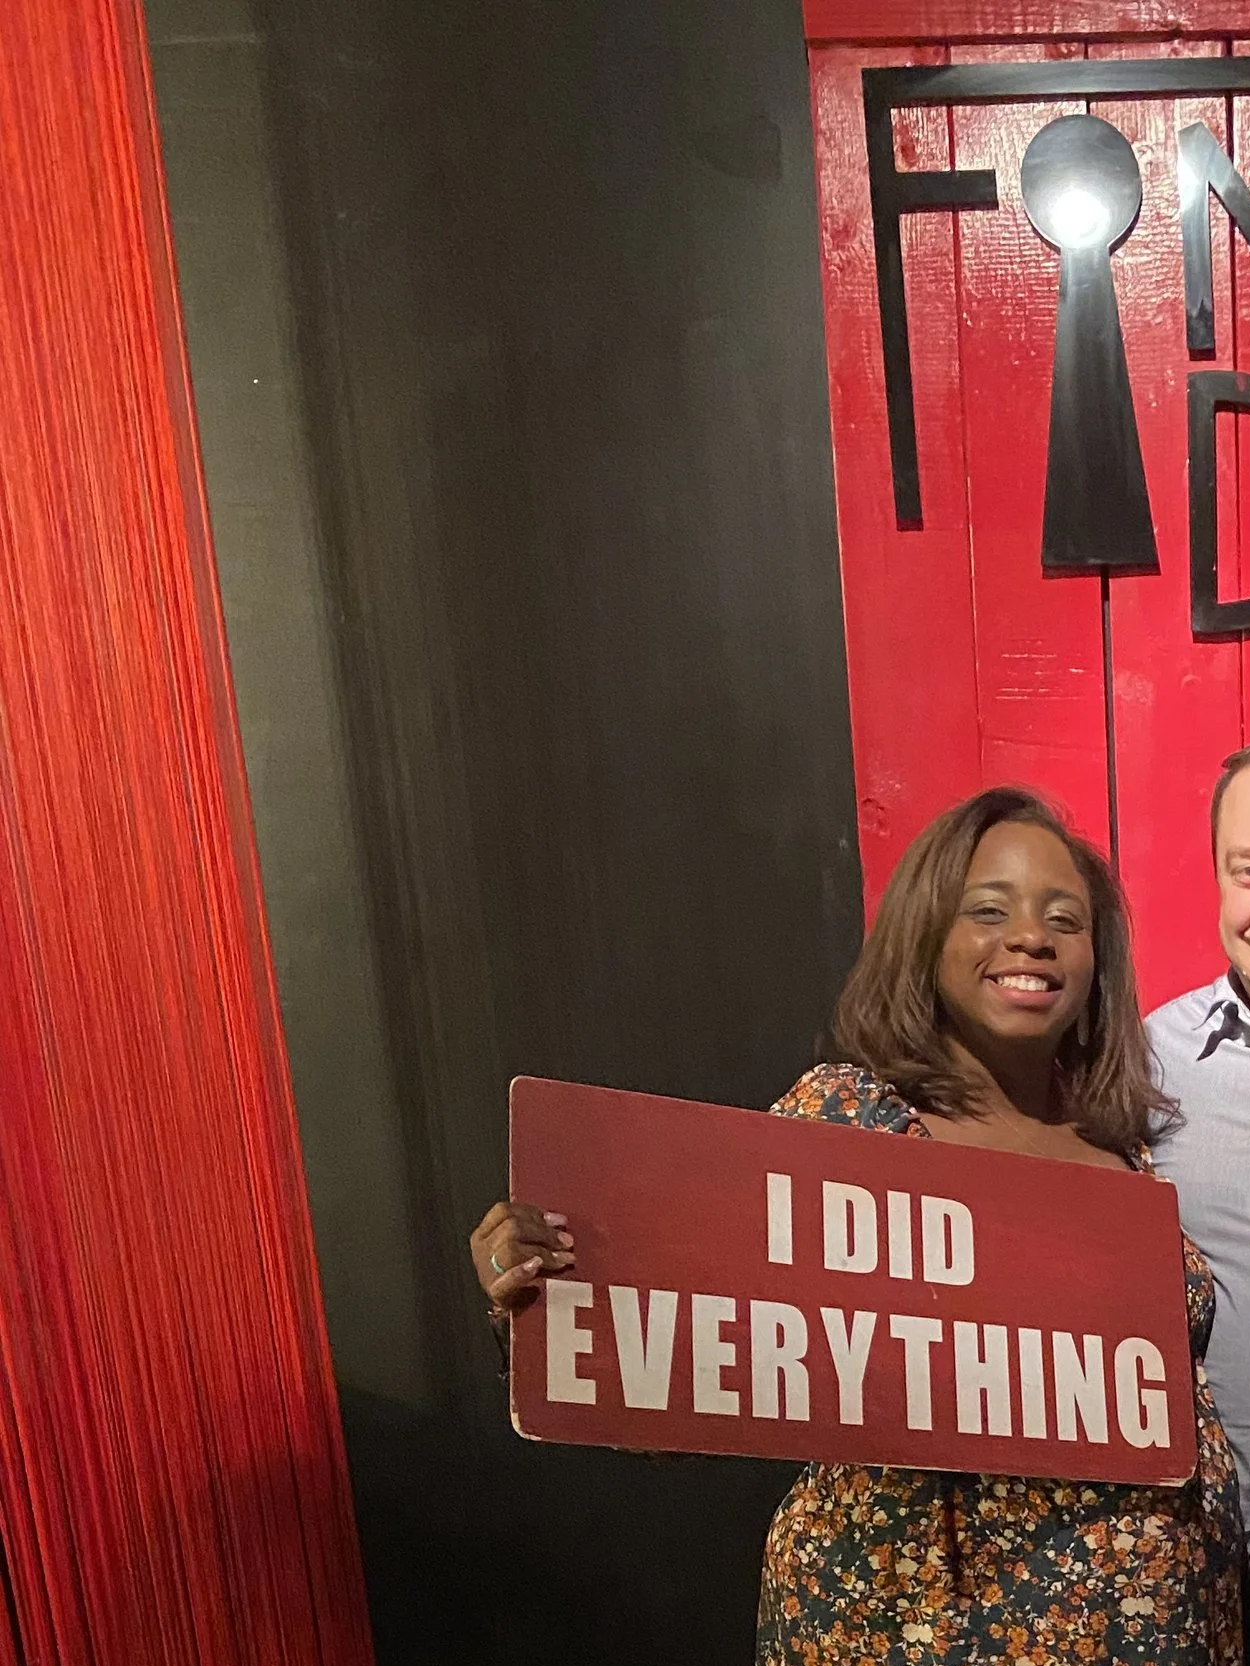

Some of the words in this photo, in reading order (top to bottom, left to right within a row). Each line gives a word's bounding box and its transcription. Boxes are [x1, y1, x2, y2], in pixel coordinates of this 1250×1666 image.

[766, 1172, 793, 1265] I
[822, 1180, 975, 1287] DID
[545, 1278, 1172, 1449] EVERYTHING
